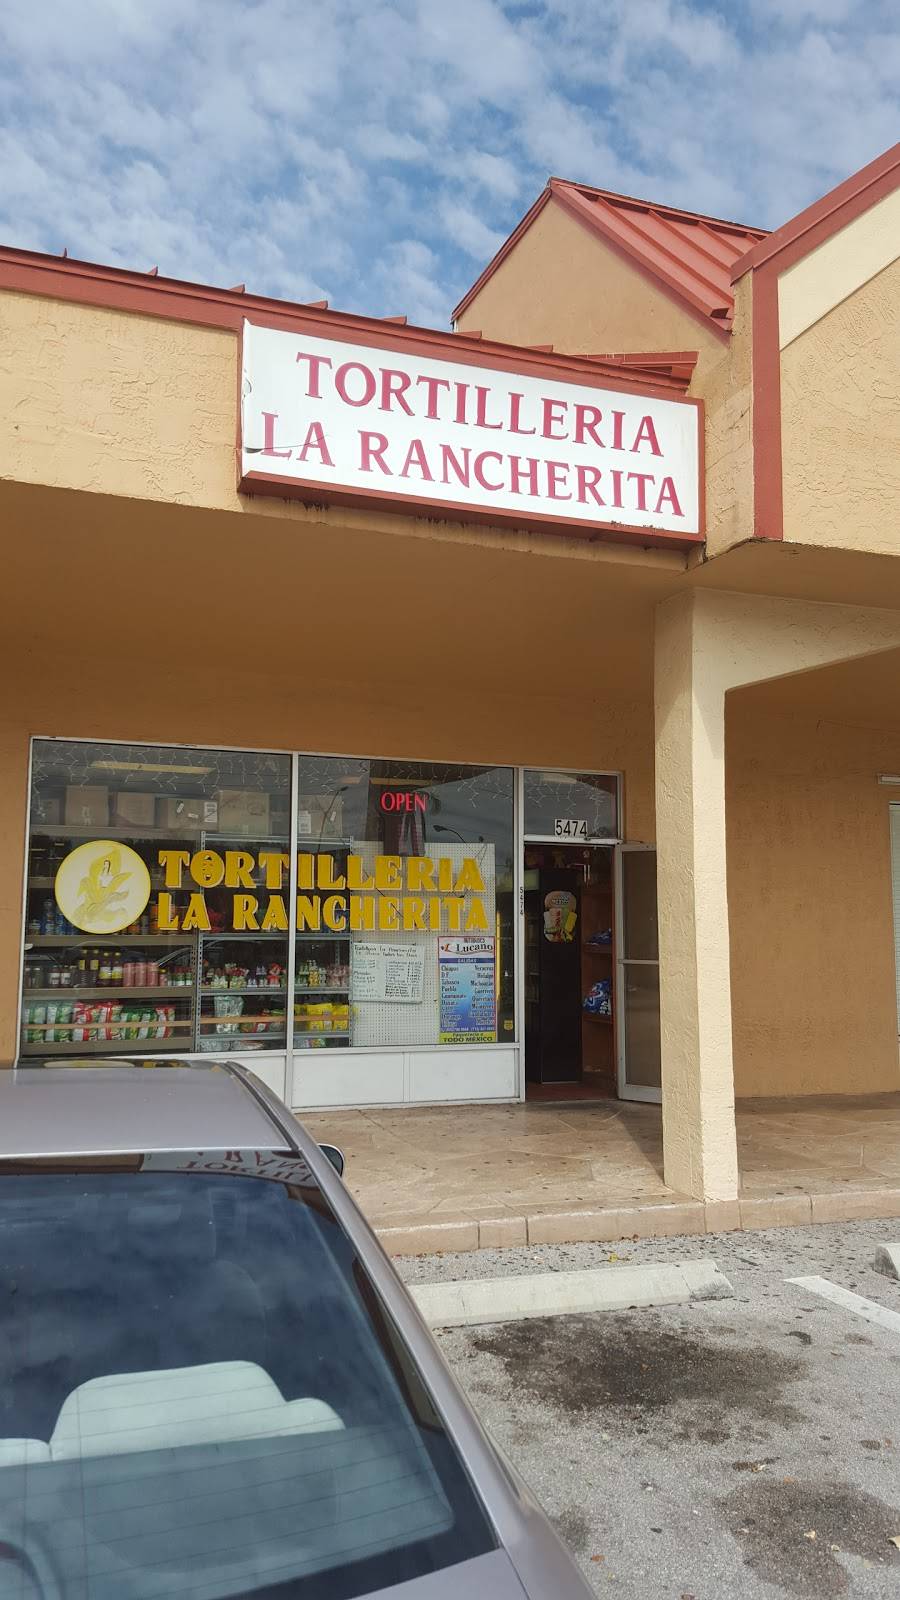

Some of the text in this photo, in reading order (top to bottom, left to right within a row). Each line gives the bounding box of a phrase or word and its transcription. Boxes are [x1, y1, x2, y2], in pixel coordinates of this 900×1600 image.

[296, 351, 665, 458] TORTILLERIA
[261, 411, 686, 517] LA RANCHERITA
[380, 792, 427, 812] OPEN
[555, 819, 588, 837] 5474
[158, 850, 487, 893] TORTILLERIA
[157, 892, 490, 932] LA RANCHERITA
[456, 943, 493, 952] Lucano
